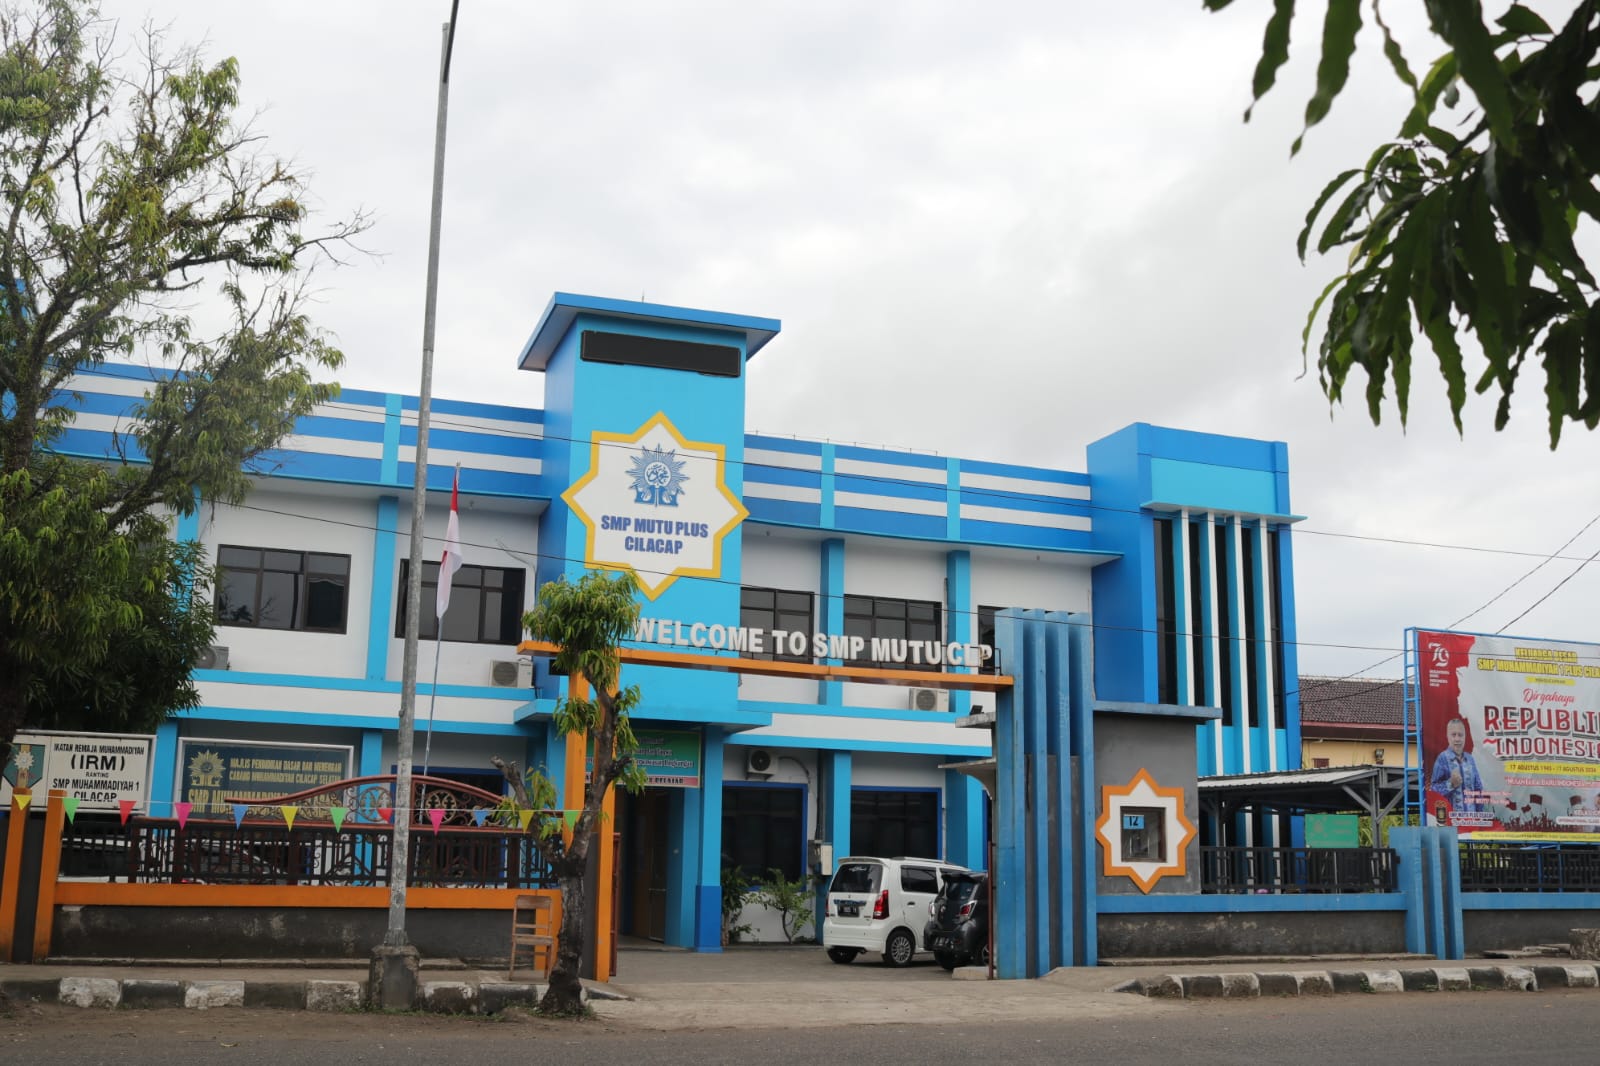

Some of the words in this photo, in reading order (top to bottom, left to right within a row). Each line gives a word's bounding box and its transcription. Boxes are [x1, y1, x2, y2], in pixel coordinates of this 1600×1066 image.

[601, 514, 632, 531] SMP
[634, 518, 673, 535] MUTU
[675, 521, 709, 538] PLUS
[624, 535, 683, 555] CILACAP
[633, 617, 764, 653] WELCOME
[772, 629, 807, 656] TO
[812, 632, 865, 660] SMP
[871, 637, 942, 665] MUTU
[1477, 657, 1496, 670] SMP
[1565, 664, 1583, 677] PLUS
[1523, 688, 1575, 706] Dirgahayu
[1484, 705, 1600, 735] REPUBLI
[54, 743, 74, 752] IKATAN
[75, 744, 98, 753] REMAJA
[99, 745, 145, 755] MUHAMMADIYAH
[1495, 738, 1600, 758] INDONESI
[53, 777, 70, 789] SMP
[71, 779, 134, 791] MUHAMMADIYAH
[135, 781, 140, 792] 1
[73, 791, 118, 803] CILACAP
